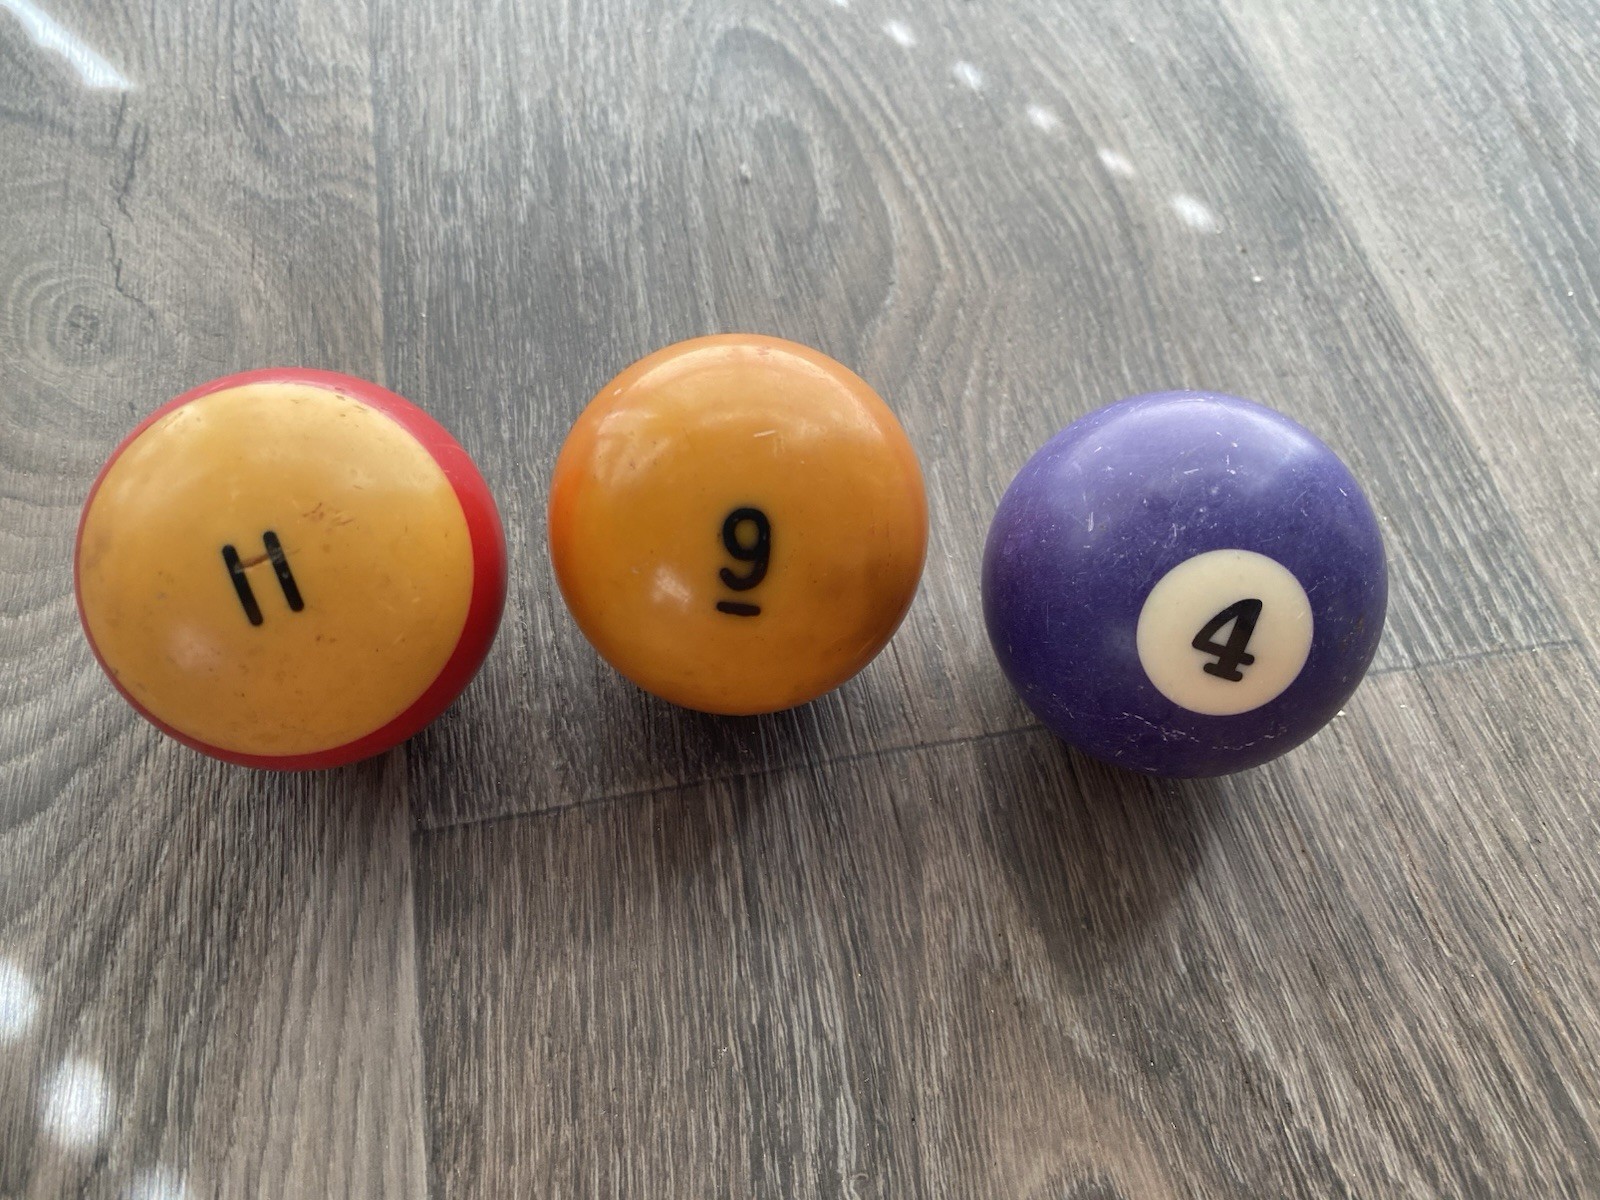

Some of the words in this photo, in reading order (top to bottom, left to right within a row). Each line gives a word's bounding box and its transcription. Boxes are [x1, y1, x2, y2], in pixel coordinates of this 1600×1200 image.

[221, 530, 305, 627] 11
[717, 507, 772, 593] 9
[1191, 598, 1263, 682] 4
